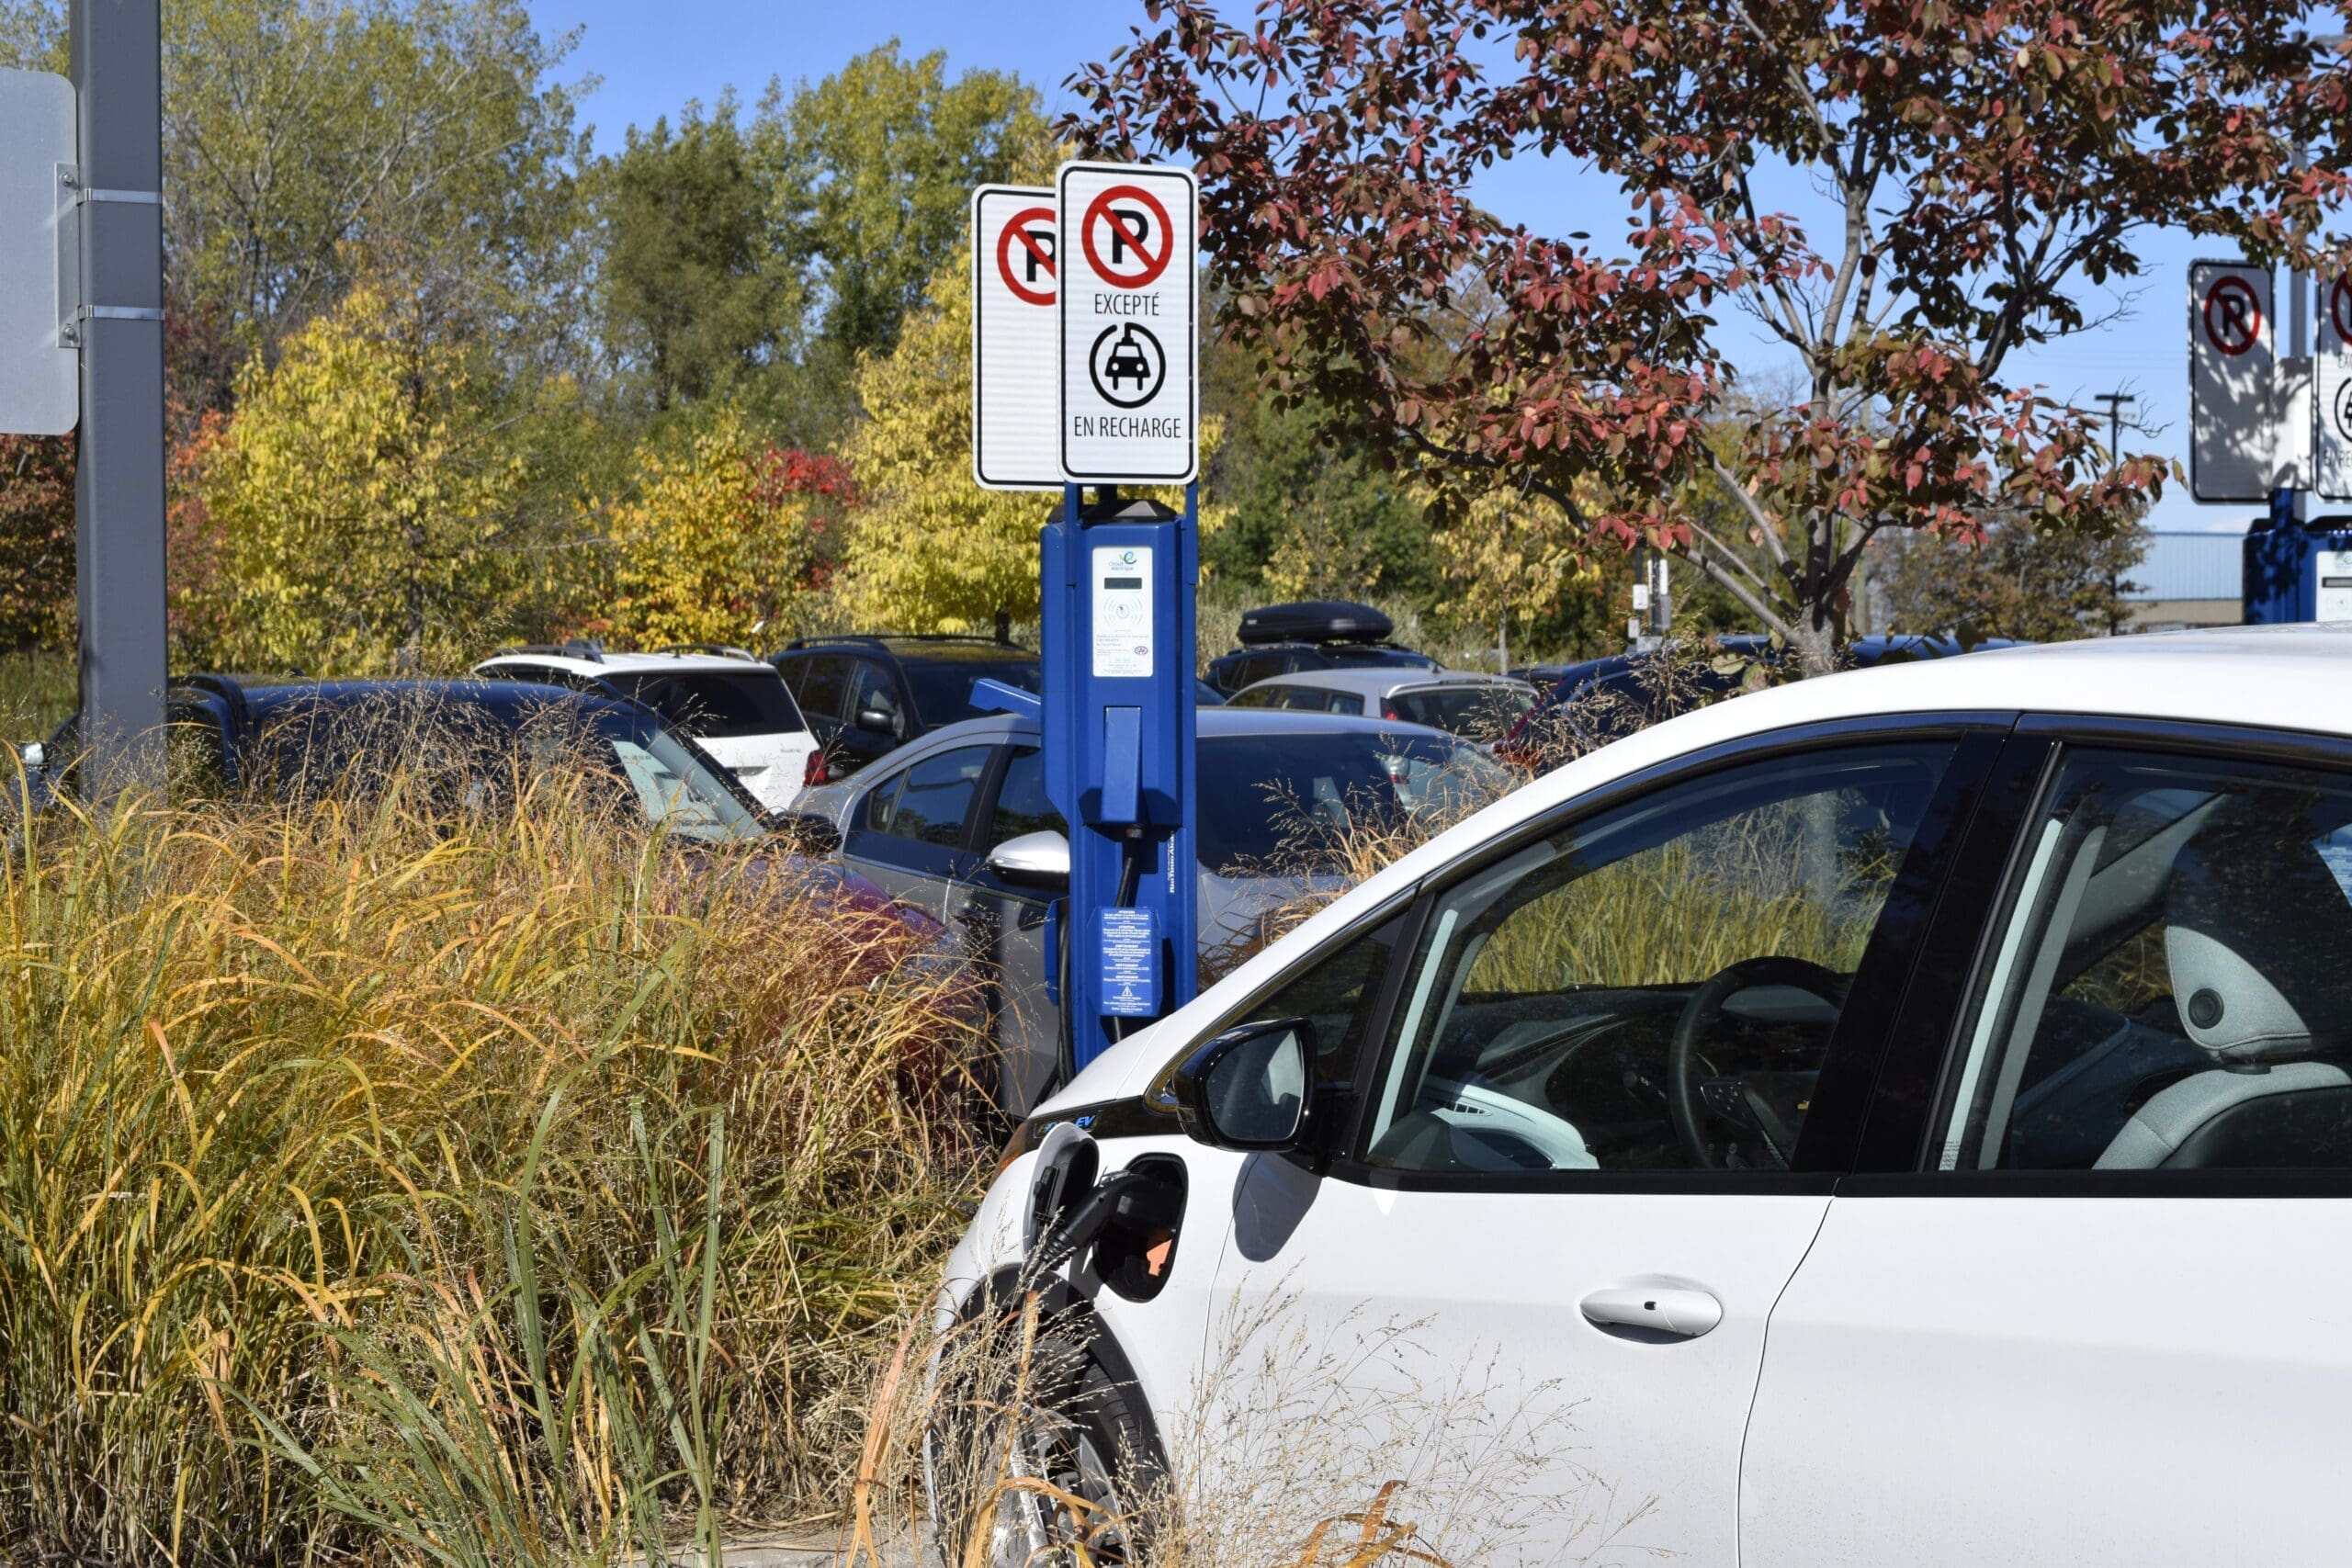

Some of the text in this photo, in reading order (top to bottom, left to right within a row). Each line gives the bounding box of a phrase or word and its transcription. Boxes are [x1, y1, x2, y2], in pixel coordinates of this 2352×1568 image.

[1094, 292, 1160, 316] EXCEPTÉ
[1074, 416, 1182, 439] EN RECHARGE
[1075, 1115, 1095, 1128] EV
